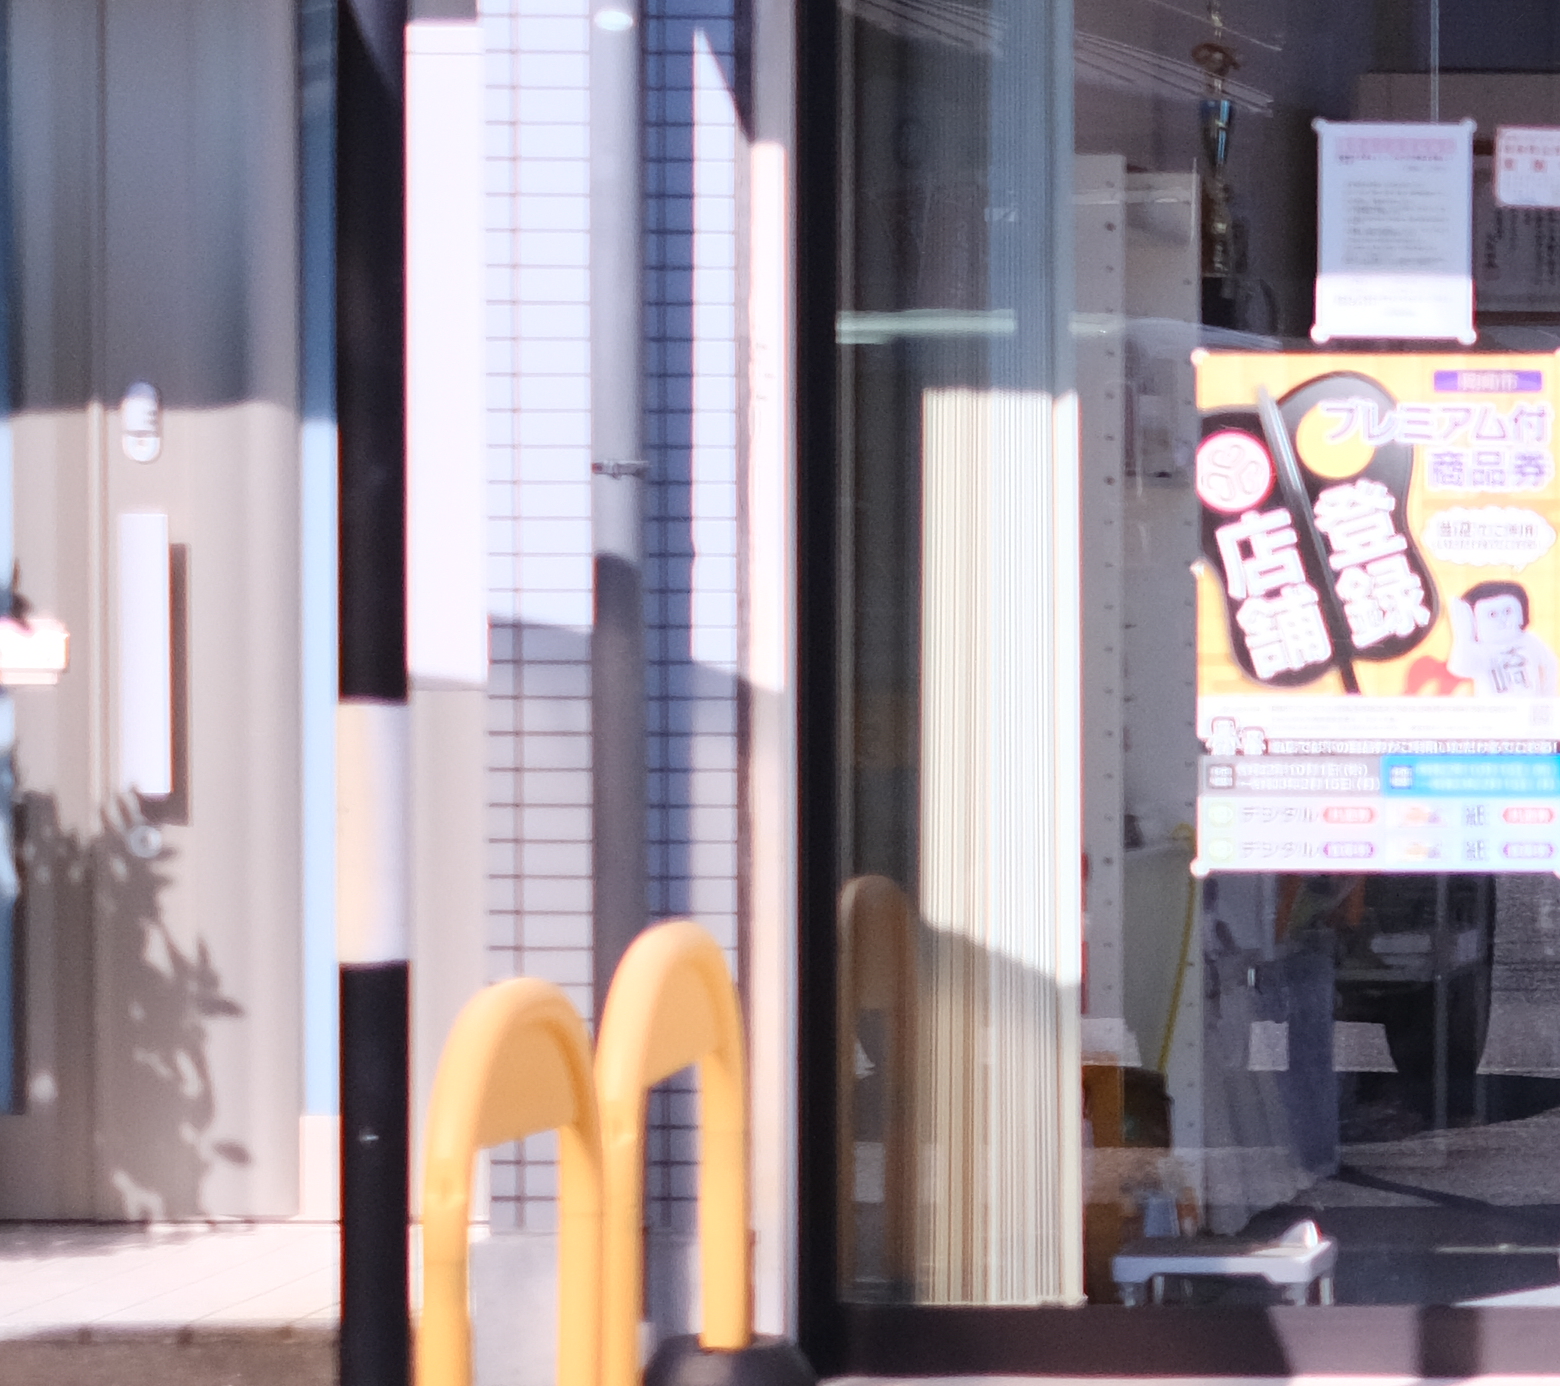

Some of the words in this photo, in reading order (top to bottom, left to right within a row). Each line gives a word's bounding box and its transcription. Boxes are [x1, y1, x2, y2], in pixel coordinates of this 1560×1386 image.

[1321, 398, 1550, 445] プレミアム付
[1430, 451, 1549, 488] 商品券
